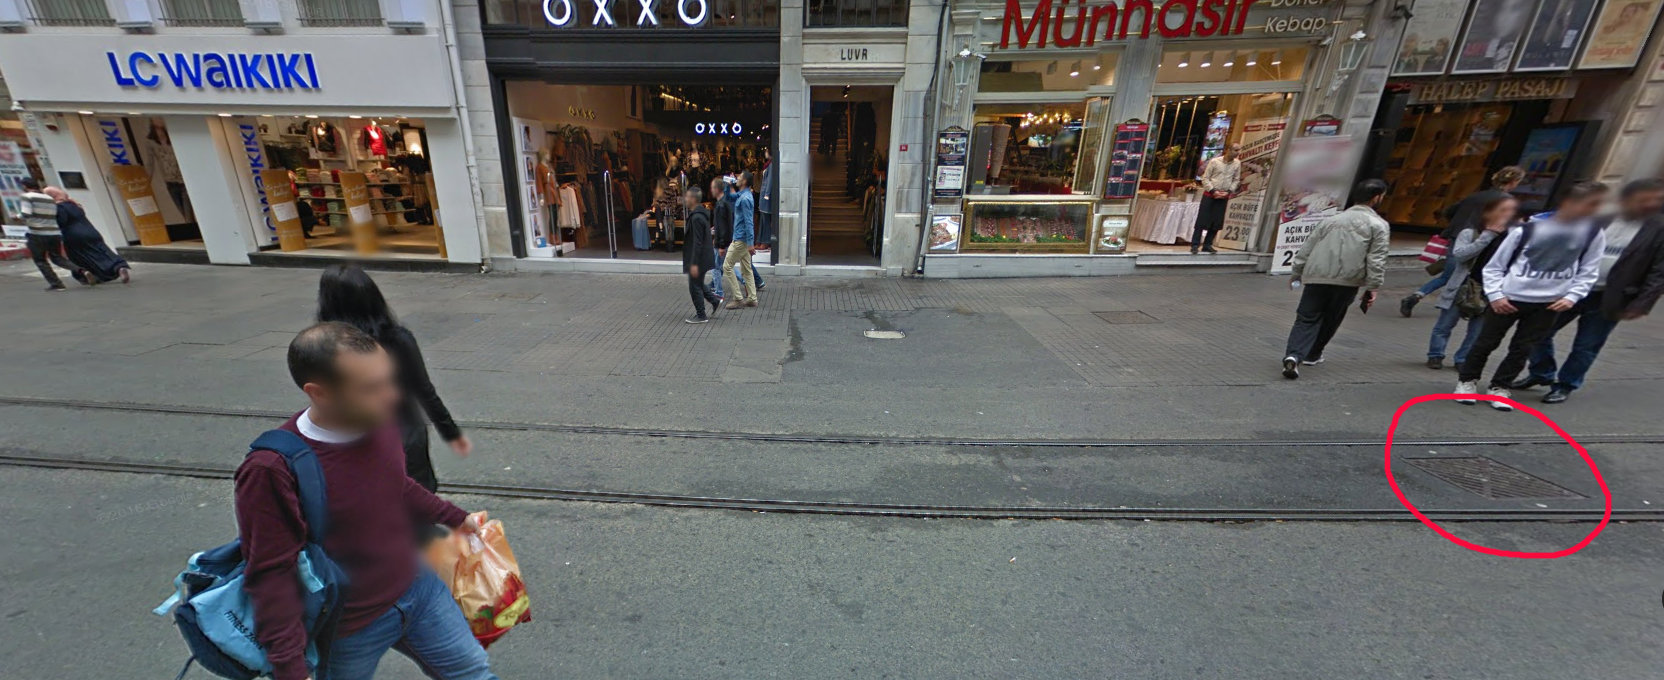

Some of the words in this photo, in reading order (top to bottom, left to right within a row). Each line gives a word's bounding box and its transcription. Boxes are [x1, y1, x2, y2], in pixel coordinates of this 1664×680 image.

[543, 0, 707, 26] OXXO
[1265, 16, 1326, 33] Kebap
[840, 48, 868, 61] LUVR
[106, 52, 160, 87] LC
[1420, 80, 1490, 101] HALEP
[1493, 78, 1569, 99] PASAJI
[695, 122, 742, 134] OXXO
[1223, 225, 1240, 241] 23
[1284, 226, 1303, 236] AÇIK
[1281, 250, 1299, 267] 2
